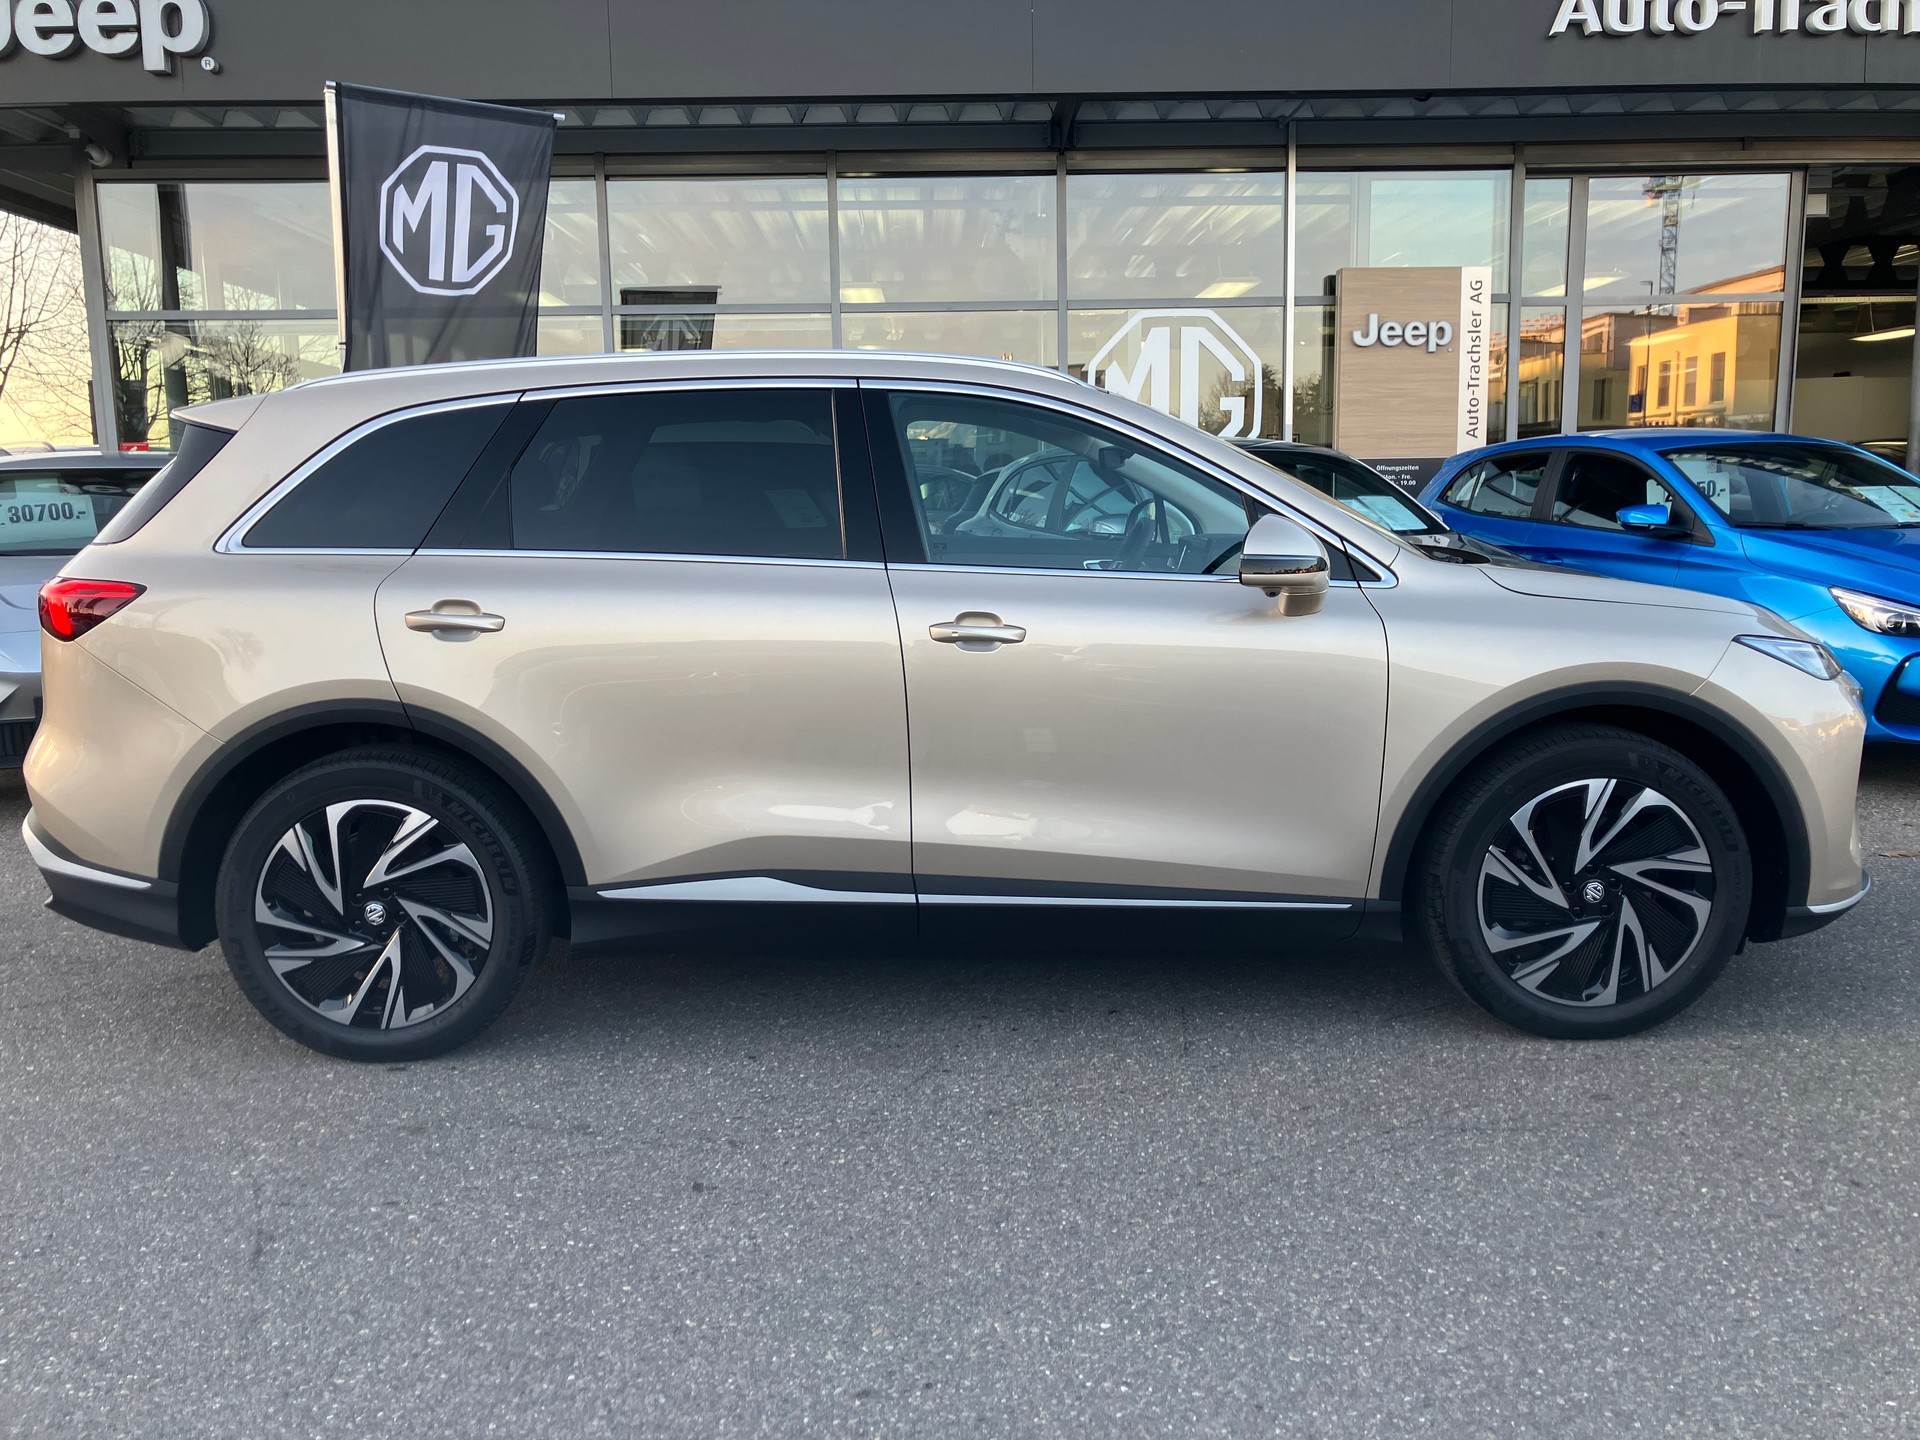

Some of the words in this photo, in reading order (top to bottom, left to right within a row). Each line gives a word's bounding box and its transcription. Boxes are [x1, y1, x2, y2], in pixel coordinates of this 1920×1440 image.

[0, 0, 210, 73] eep
[391, 160, 508, 283] MG
[1470, 280, 1482, 304] AG
[1352, 313, 1453, 353] Jeep
[1104, 325, 1247, 438] MG
[1466, 311, 1482, 438] Auto-Trachsler
[7, 502, 86, 524] 30700.-
